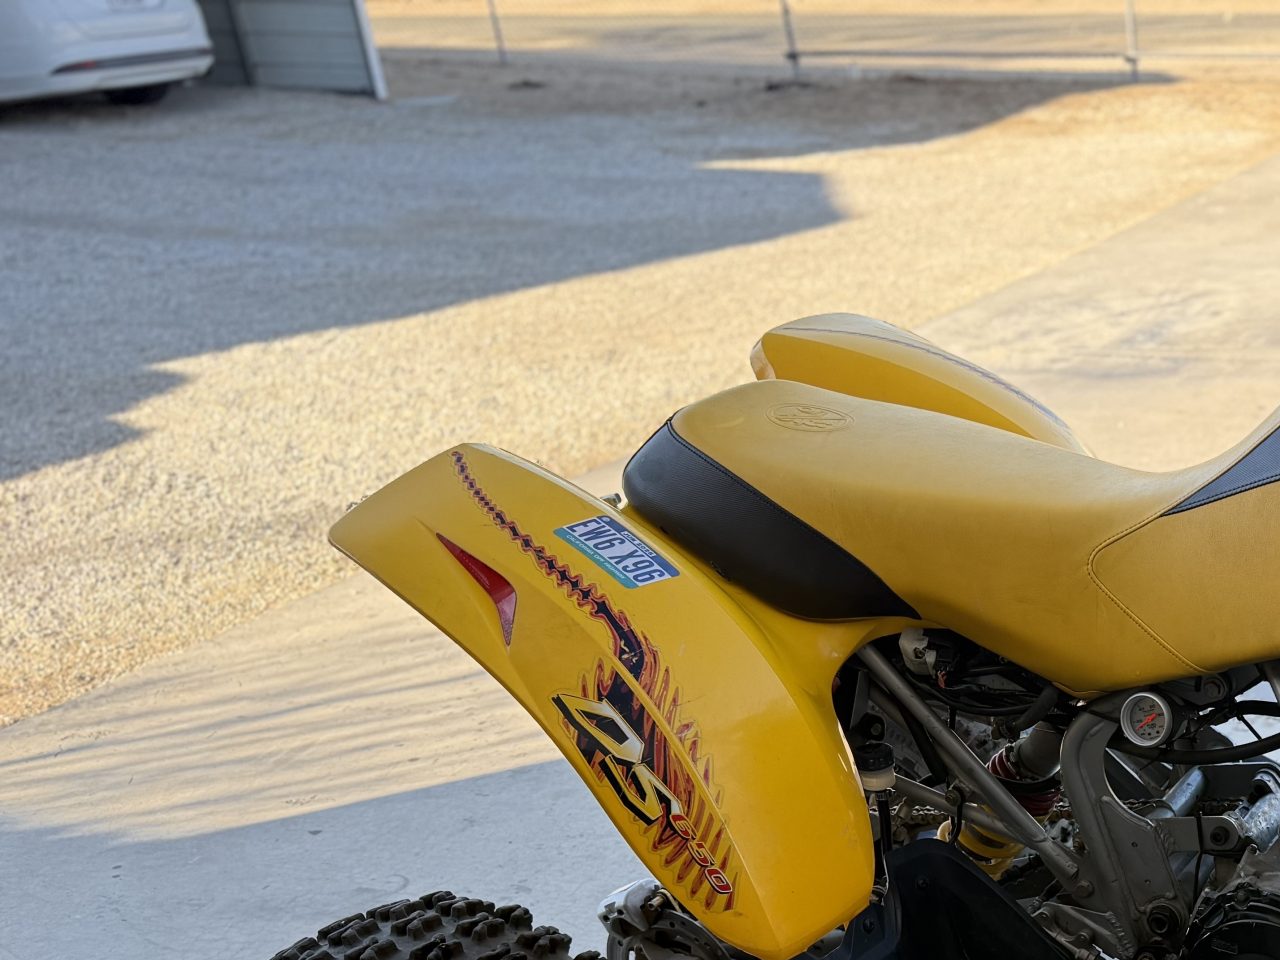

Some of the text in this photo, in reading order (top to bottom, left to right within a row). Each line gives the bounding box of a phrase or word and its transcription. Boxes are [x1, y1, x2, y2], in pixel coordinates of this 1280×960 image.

[565, 518, 667, 584] EW6 X96
[552, 693, 684, 826] DS
[669, 813, 733, 893] 650
